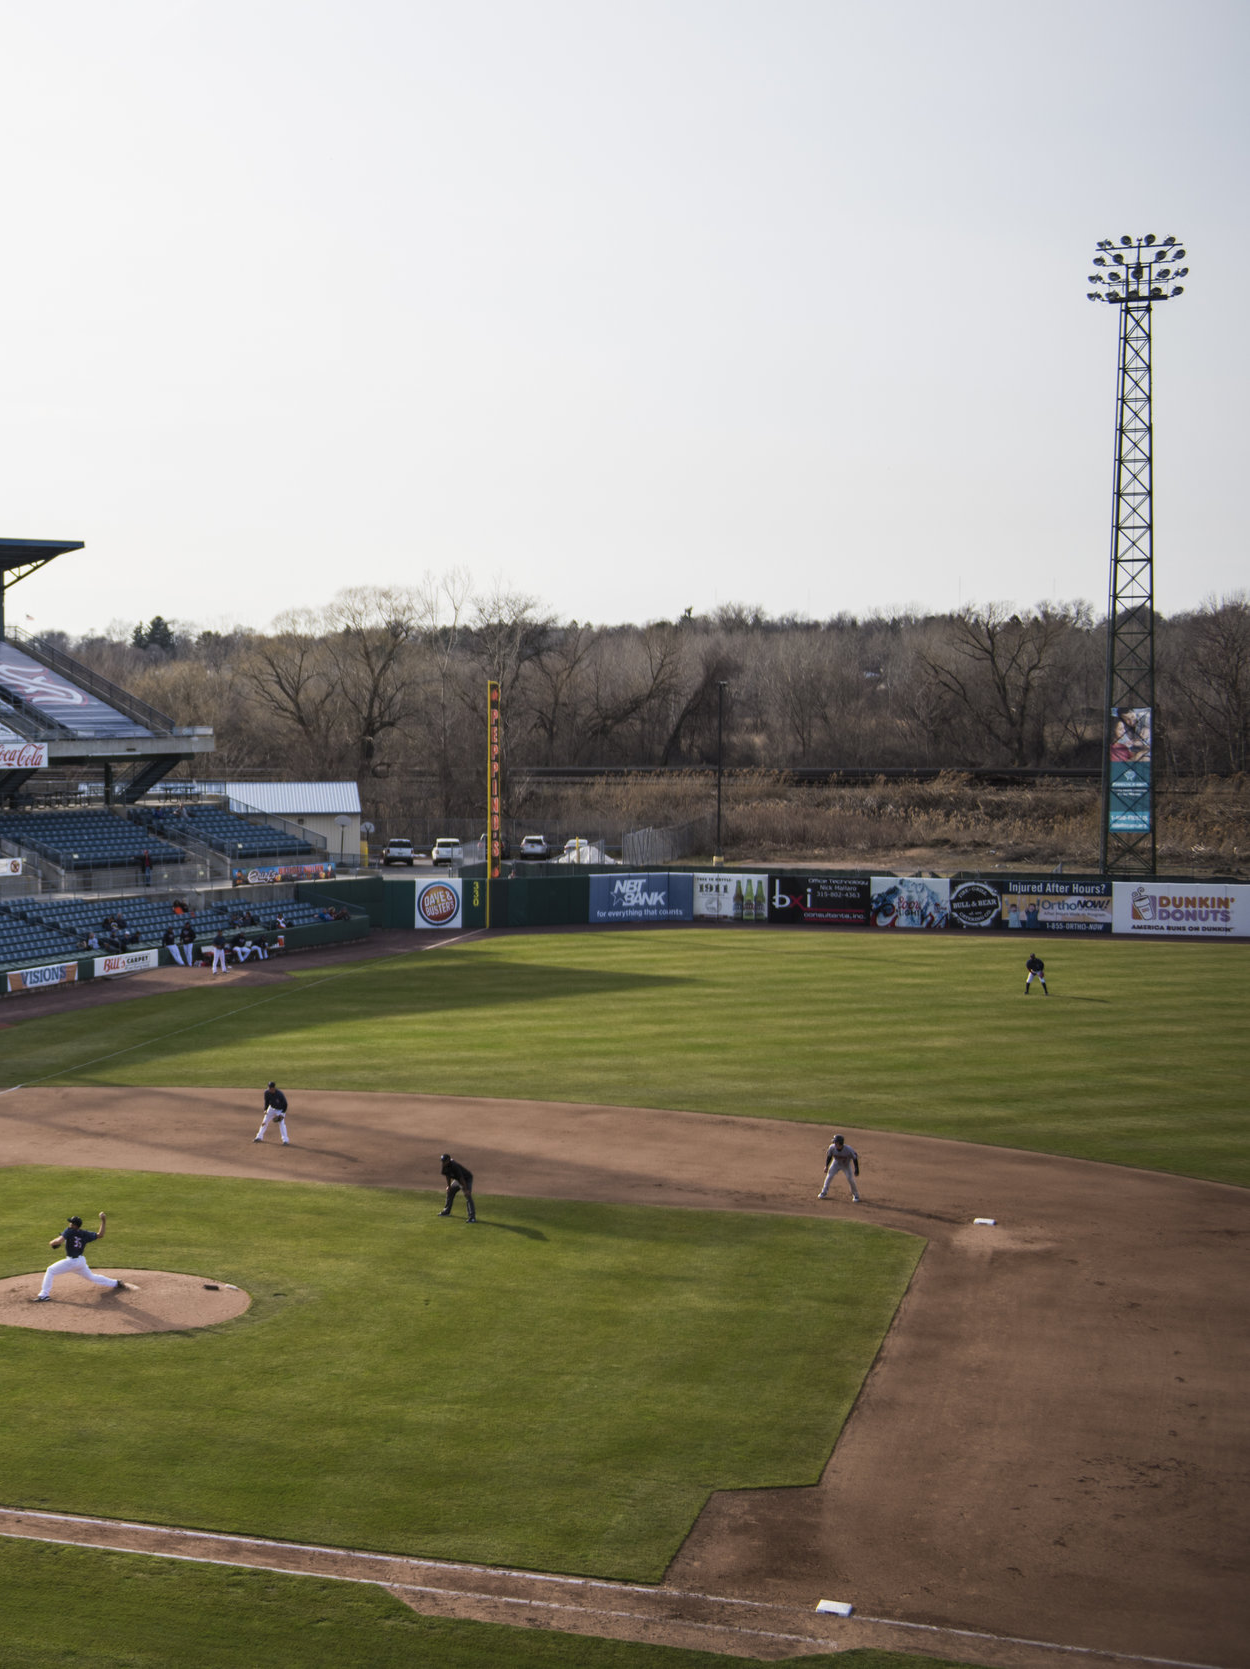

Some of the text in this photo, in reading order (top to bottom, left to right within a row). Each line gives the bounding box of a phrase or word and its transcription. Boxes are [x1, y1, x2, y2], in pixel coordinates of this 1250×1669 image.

[490, 709, 499, 857] PEPPINO'S
[614, 878, 646, 893] NBT
[699, 883, 728, 894] 1911
[1009, 882, 1106, 895] Injured After Hours?
[424, 890, 453, 907] DAVE &
[623, 891, 667, 906] BANK
[952, 901, 970, 909] BULL
[1158, 896, 1236, 909] DUNKIN'
[597, 909, 607, 918] for
[607, 908, 643, 918] everything
[643, 908, 657, 916] that
[1158, 908, 1230, 922] DONUTS
[103, 957, 126, 973] Bill's
[127, 955, 149, 965] CARPET
[21, 965, 67, 986] VISIONS
